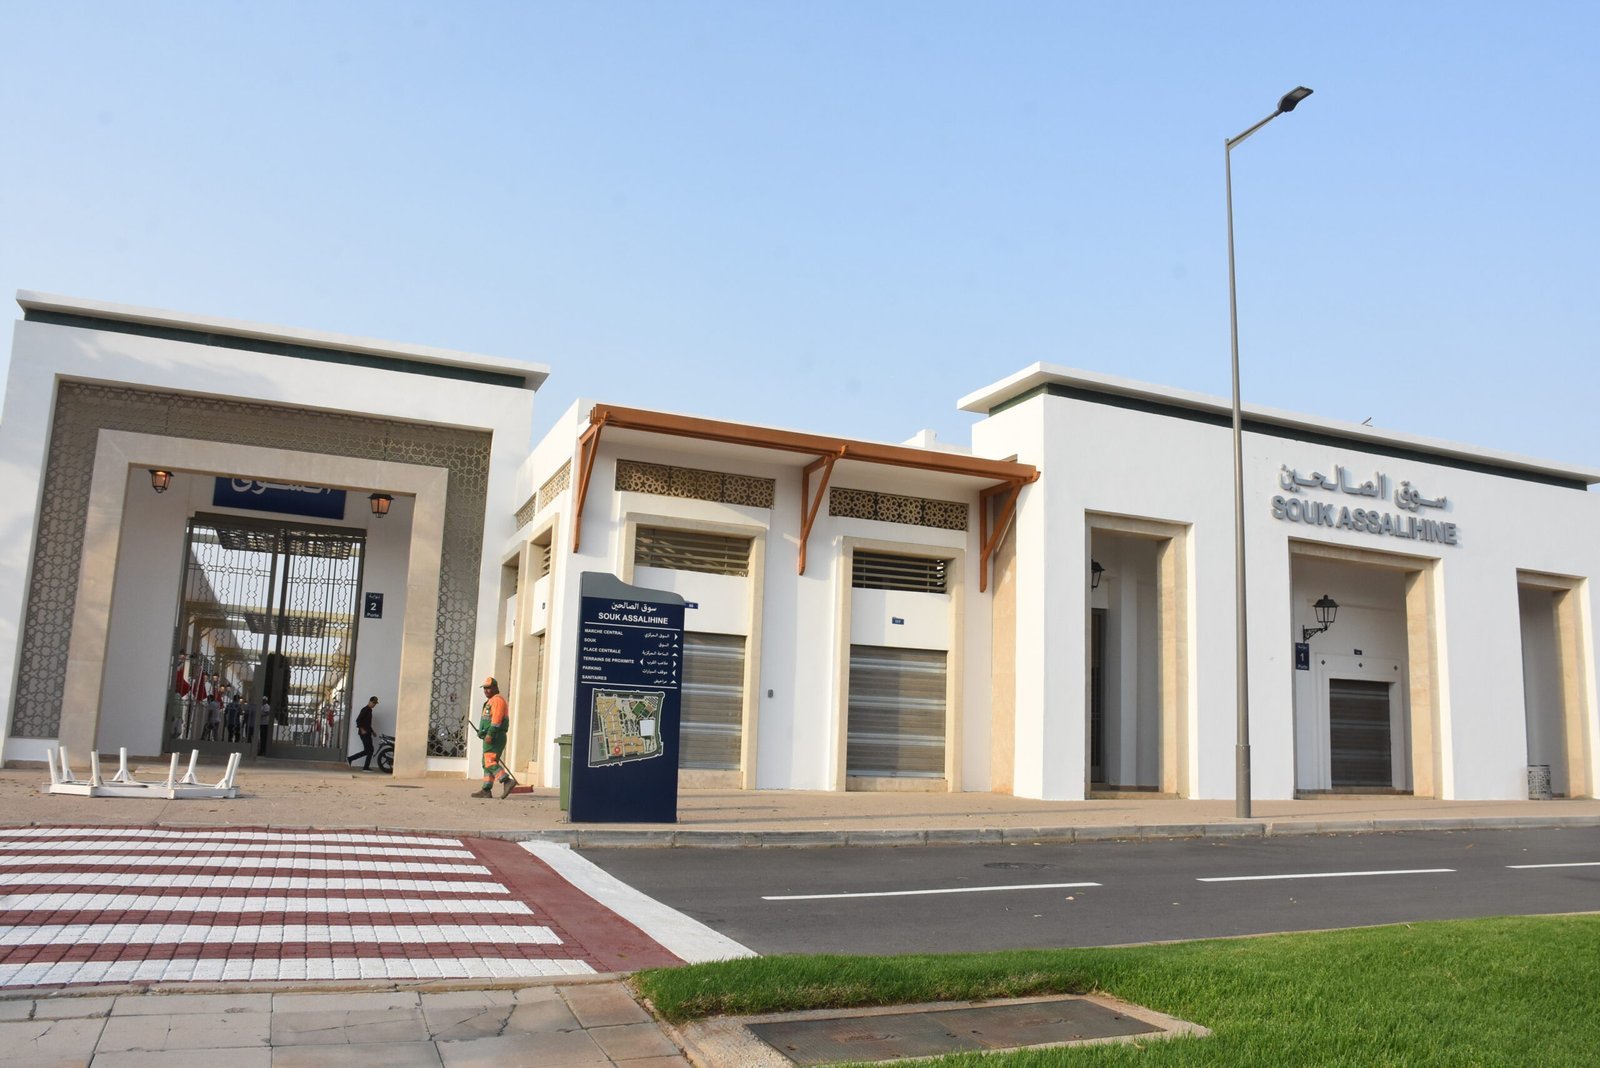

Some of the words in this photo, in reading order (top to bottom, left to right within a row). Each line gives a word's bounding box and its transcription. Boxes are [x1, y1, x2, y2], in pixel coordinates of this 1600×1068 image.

[1279, 463, 1387, 500] الصالحين
[1394, 480, 1448, 512] سوق
[1271, 495, 1334, 528] SOUK
[1336, 505, 1458, 546] ASSALIHINE
[370, 602, 377, 611] 2
[611, 602, 639, 611] الصالحين
[641, 604, 657, 613] سوق
[598, 612, 621, 620] SOUK
[622, 615, 668, 624] ASSALIHINE
[1300, 653, 1304, 662] 1
